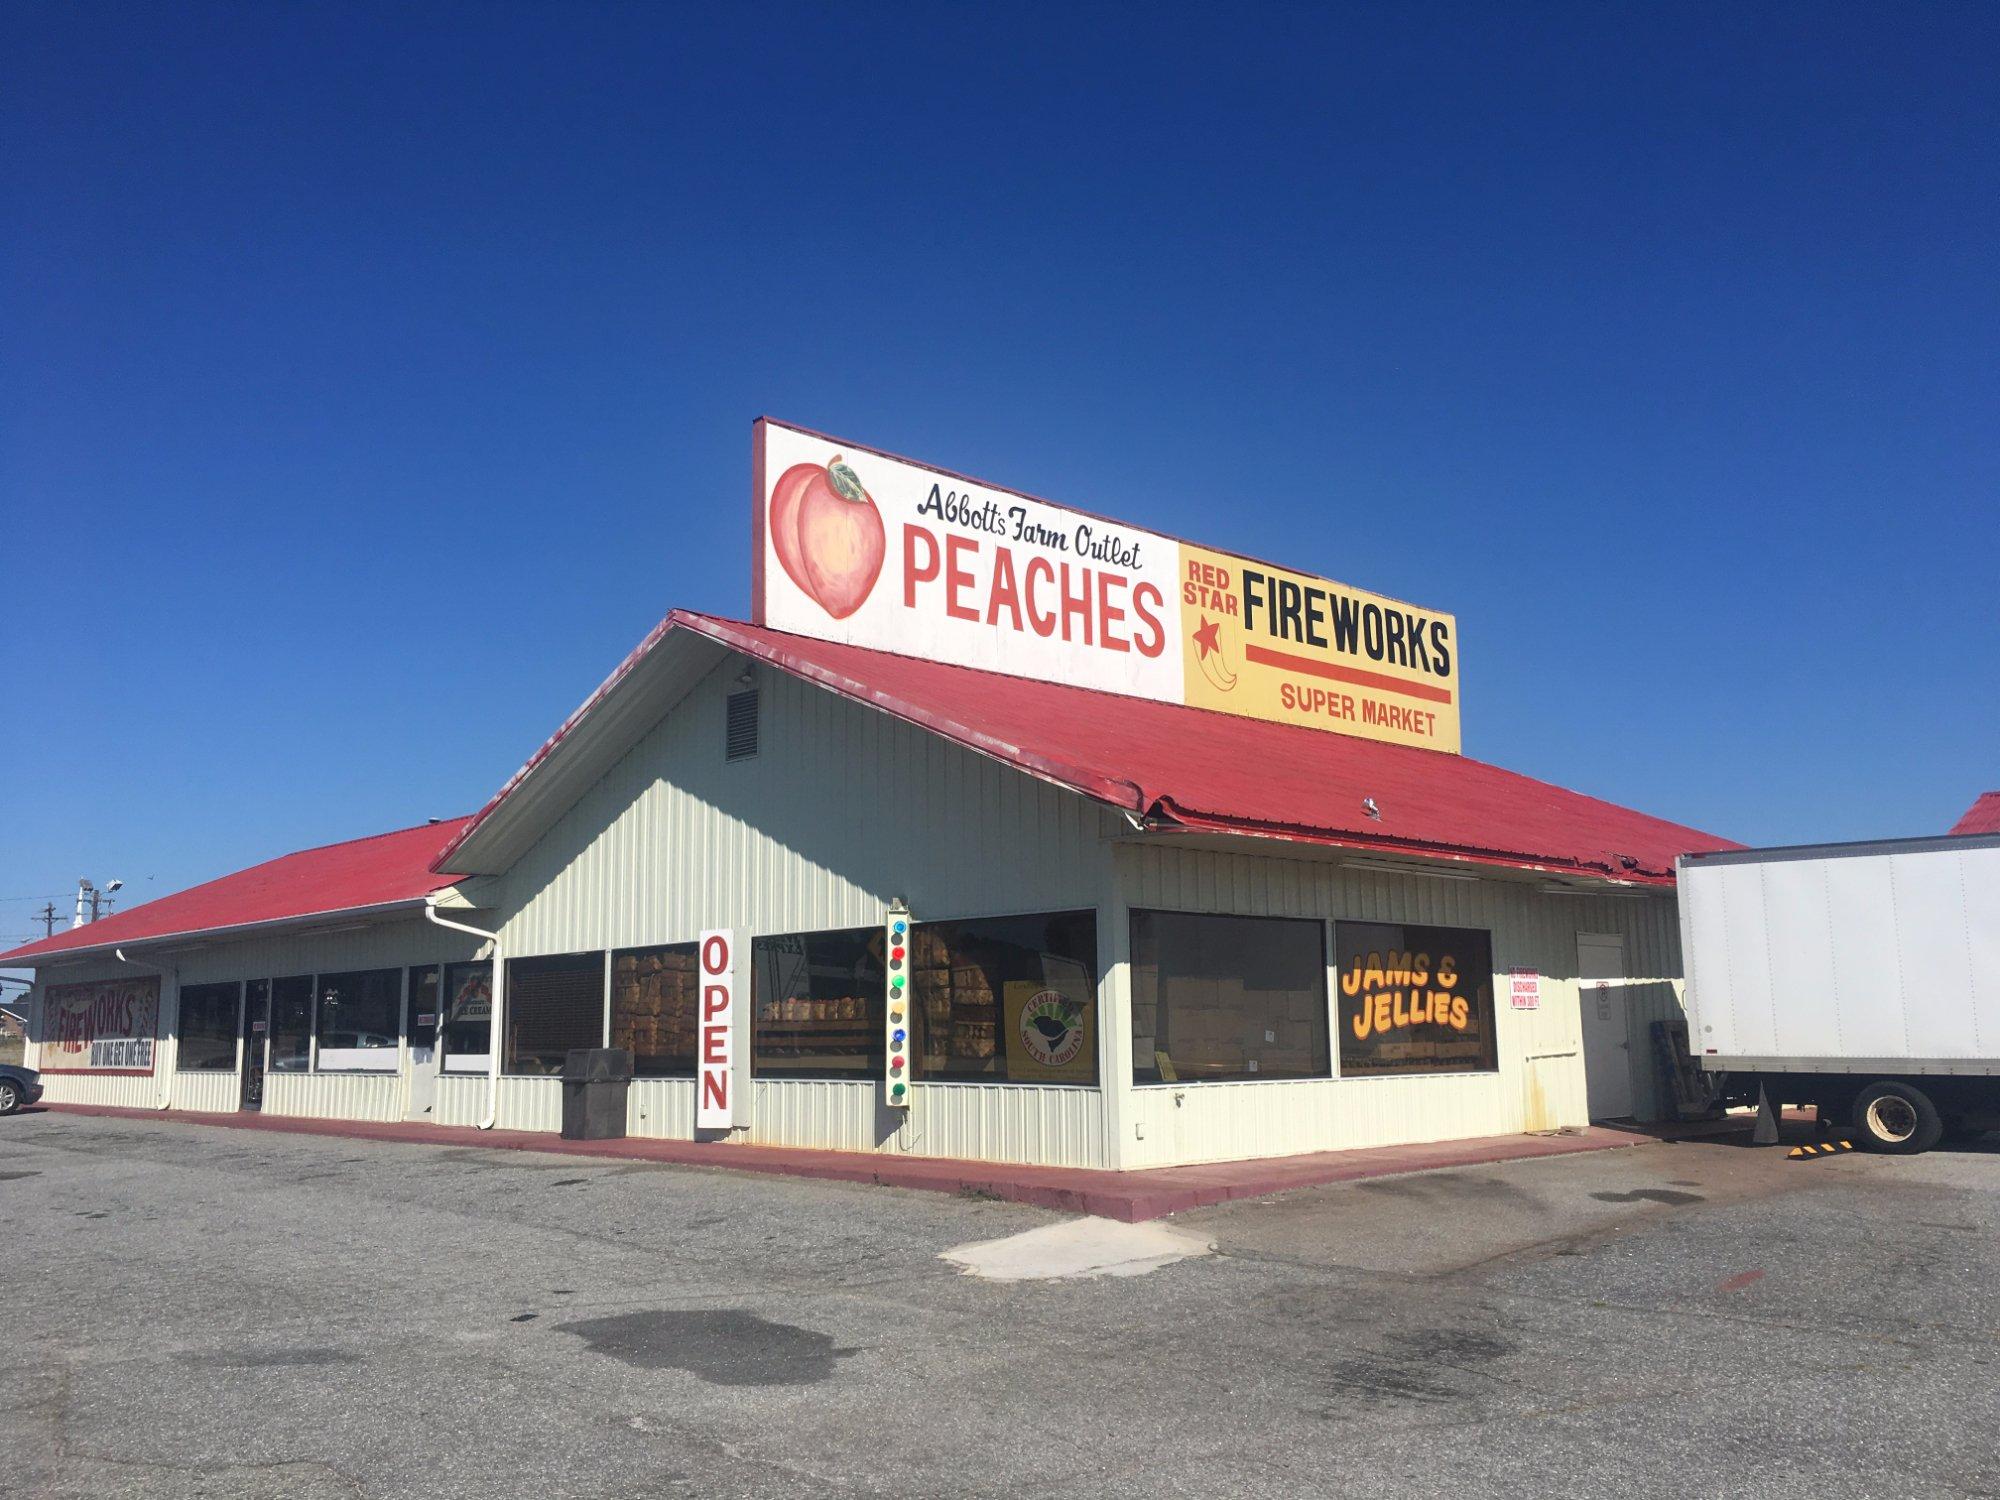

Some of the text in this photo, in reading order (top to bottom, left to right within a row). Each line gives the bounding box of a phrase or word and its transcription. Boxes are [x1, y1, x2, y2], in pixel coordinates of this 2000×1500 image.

[917, 483, 1143, 570] Abbott's Farm Outlet
[903, 522, 1166, 659] PEACHES
[1183, 581, 1238, 617] STAR
[1188, 560, 1230, 590] RED
[1242, 569, 1451, 678] FIREWORKS
[1280, 683, 1436, 737] SUPER MARKET
[1342, 949, 1458, 997] JAMS &
[57, 989, 136, 1054] FIREWORKS
[702, 935, 730, 1110] OPEN
[1352, 988, 1470, 1040] JELLIES
[1511, 995, 1526, 1007] WITHIN
[91, 1041, 152, 1067] BUY ONE GET ONE FREE
[1022, 1030, 1083, 1065] SOUTH CAROLINA
